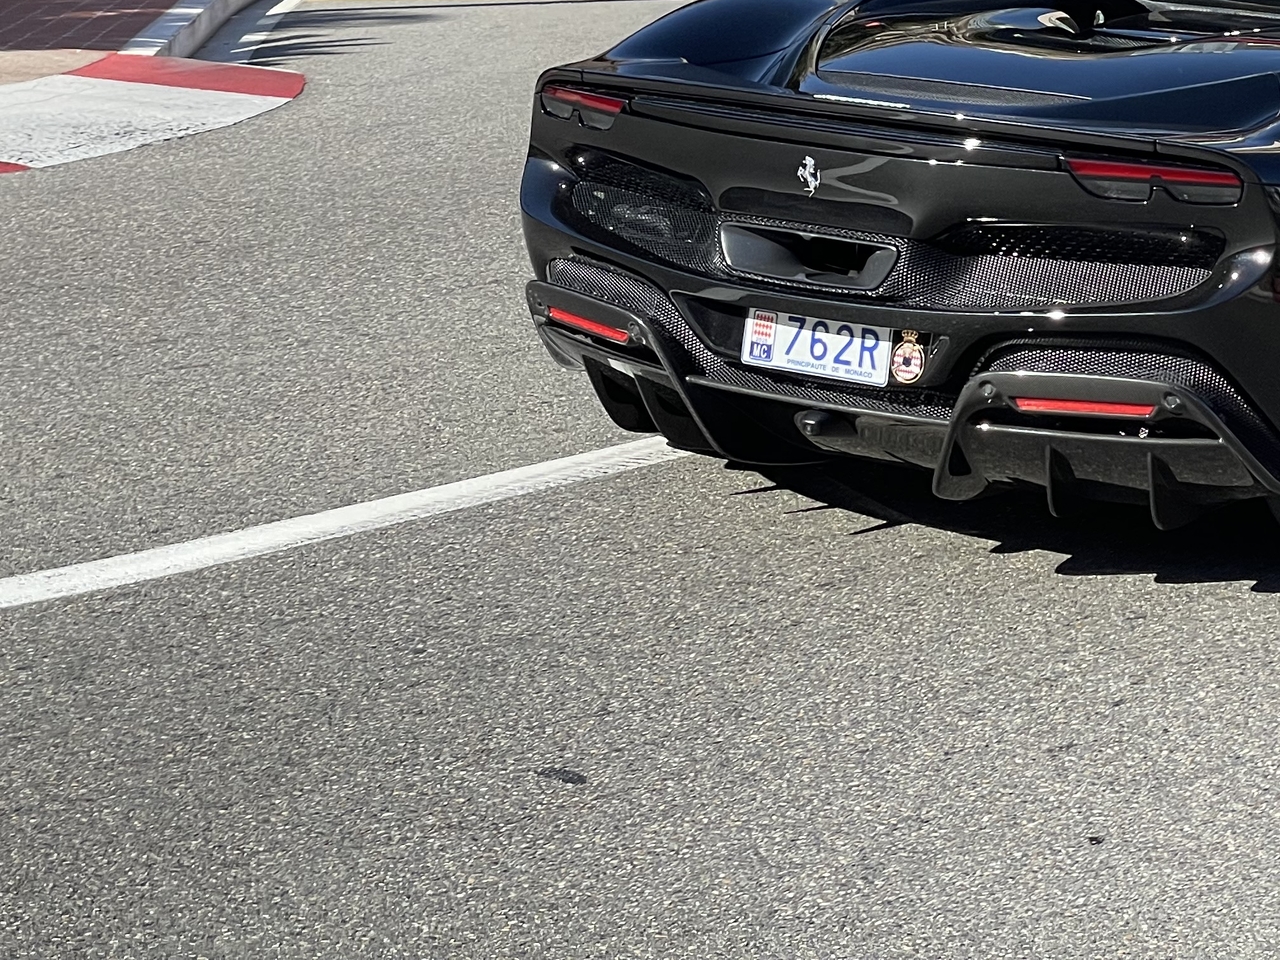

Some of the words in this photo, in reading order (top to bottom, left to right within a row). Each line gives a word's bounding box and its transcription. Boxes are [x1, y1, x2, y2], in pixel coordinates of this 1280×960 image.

[752, 343, 768, 358] MC
[784, 315, 880, 371] 762R
[786, 359, 827, 371] PRINCIPAUTE
[844, 368, 873, 379] MONACO
